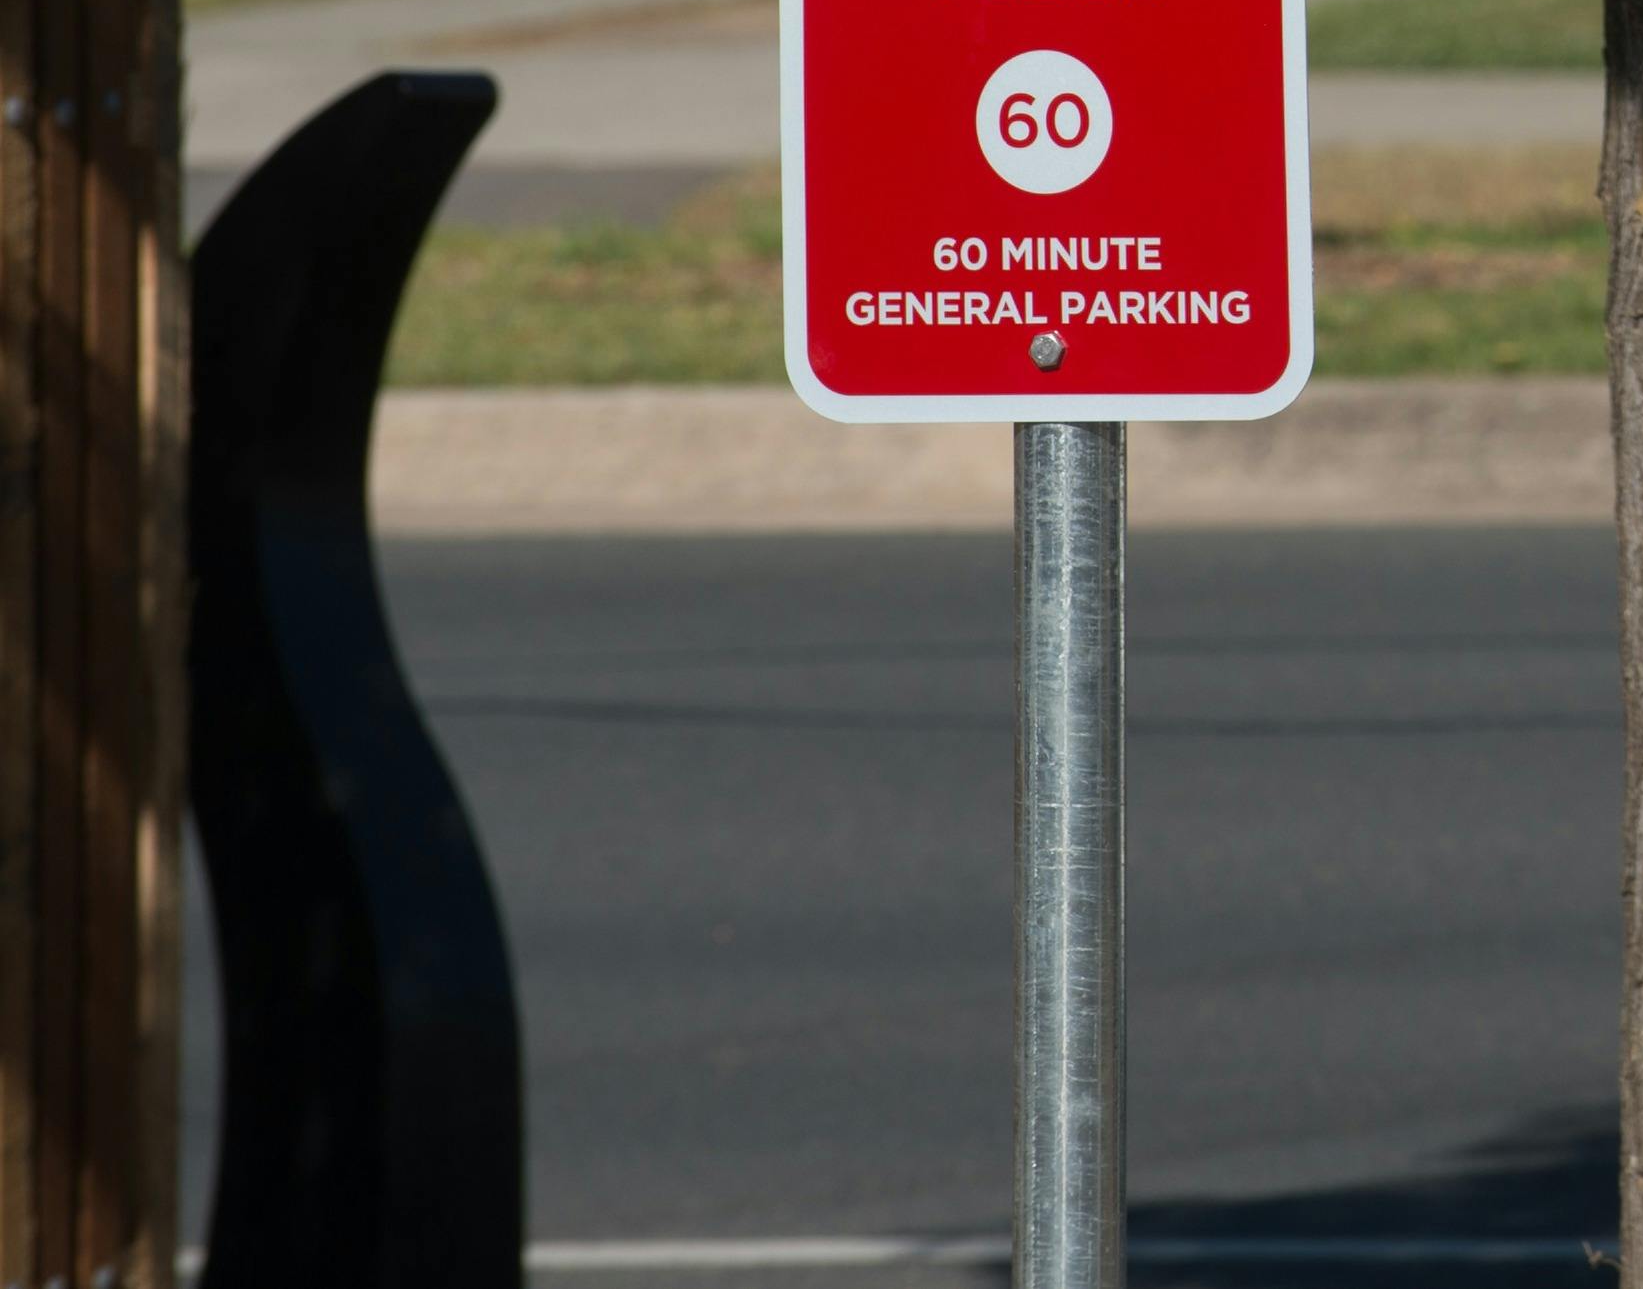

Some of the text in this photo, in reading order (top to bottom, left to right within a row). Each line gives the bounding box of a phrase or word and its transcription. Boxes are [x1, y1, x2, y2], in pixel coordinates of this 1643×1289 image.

[998, 93, 1091, 149] 60
[933, 237, 1162, 271] 60 MINUTE
[845, 290, 1251, 326] GENERAL PARKING
